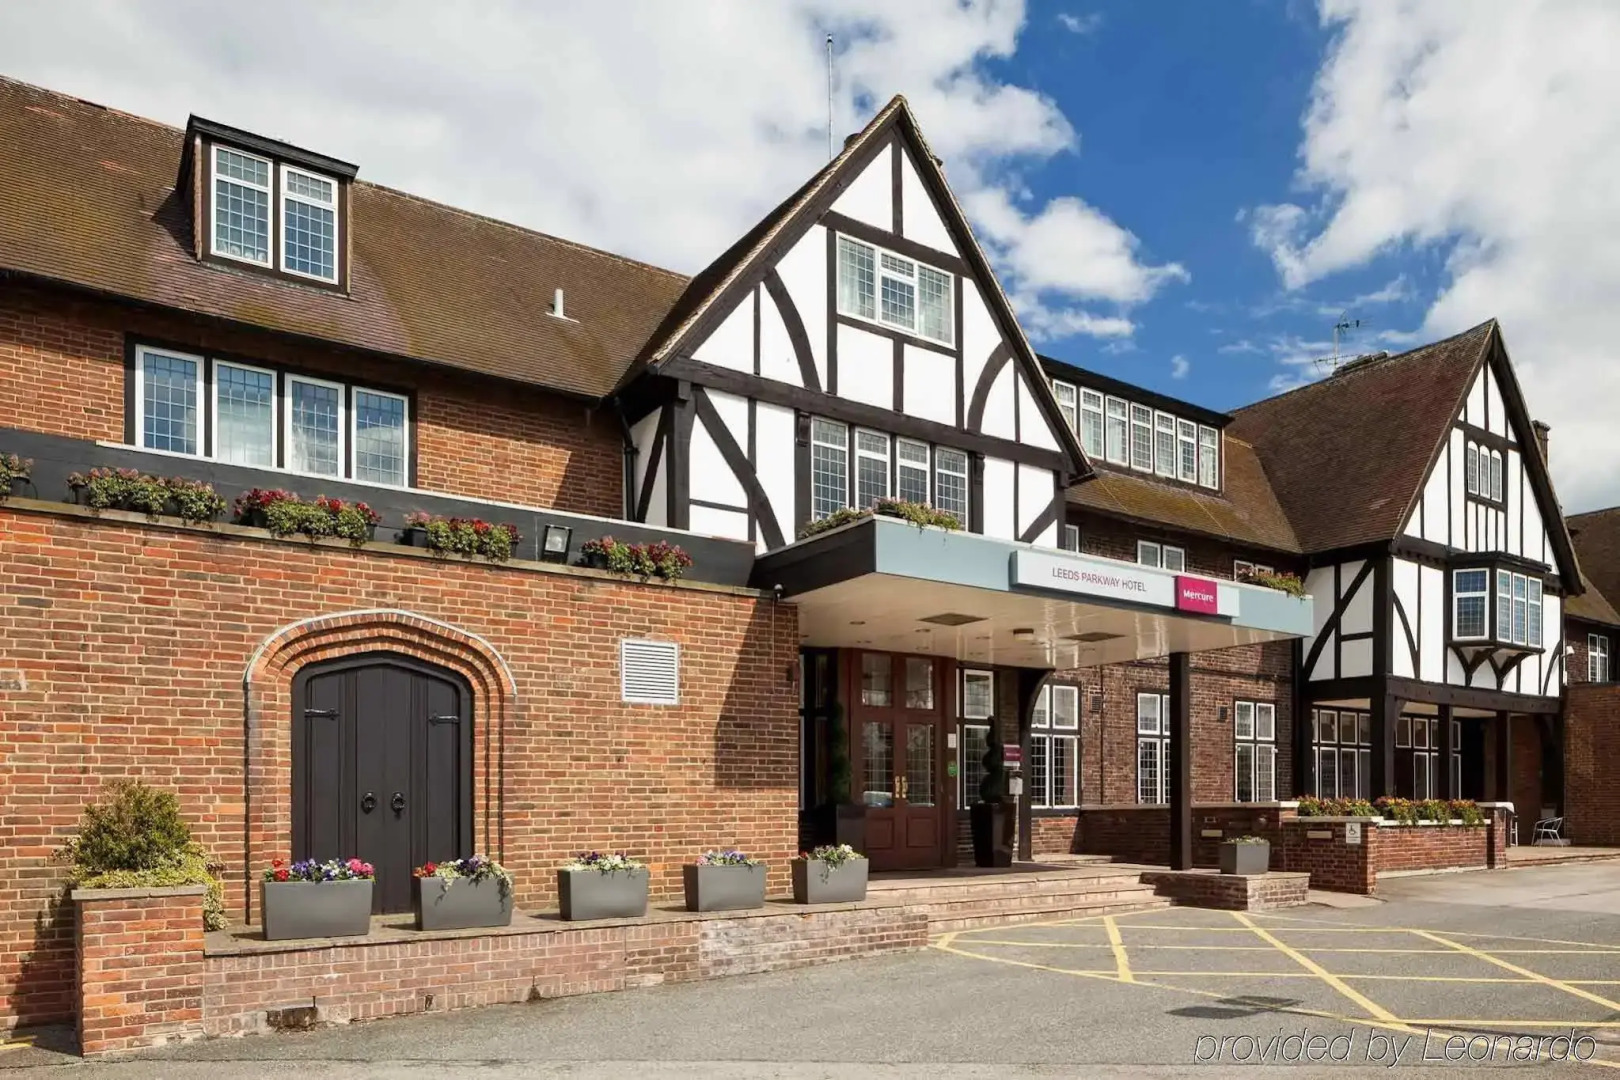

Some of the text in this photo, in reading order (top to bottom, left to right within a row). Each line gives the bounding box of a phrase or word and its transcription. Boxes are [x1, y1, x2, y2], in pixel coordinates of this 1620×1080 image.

[1052, 567, 1147, 592] LEEDS PARKWAY HOTEL
[1183, 589, 1214, 603] Mercure
